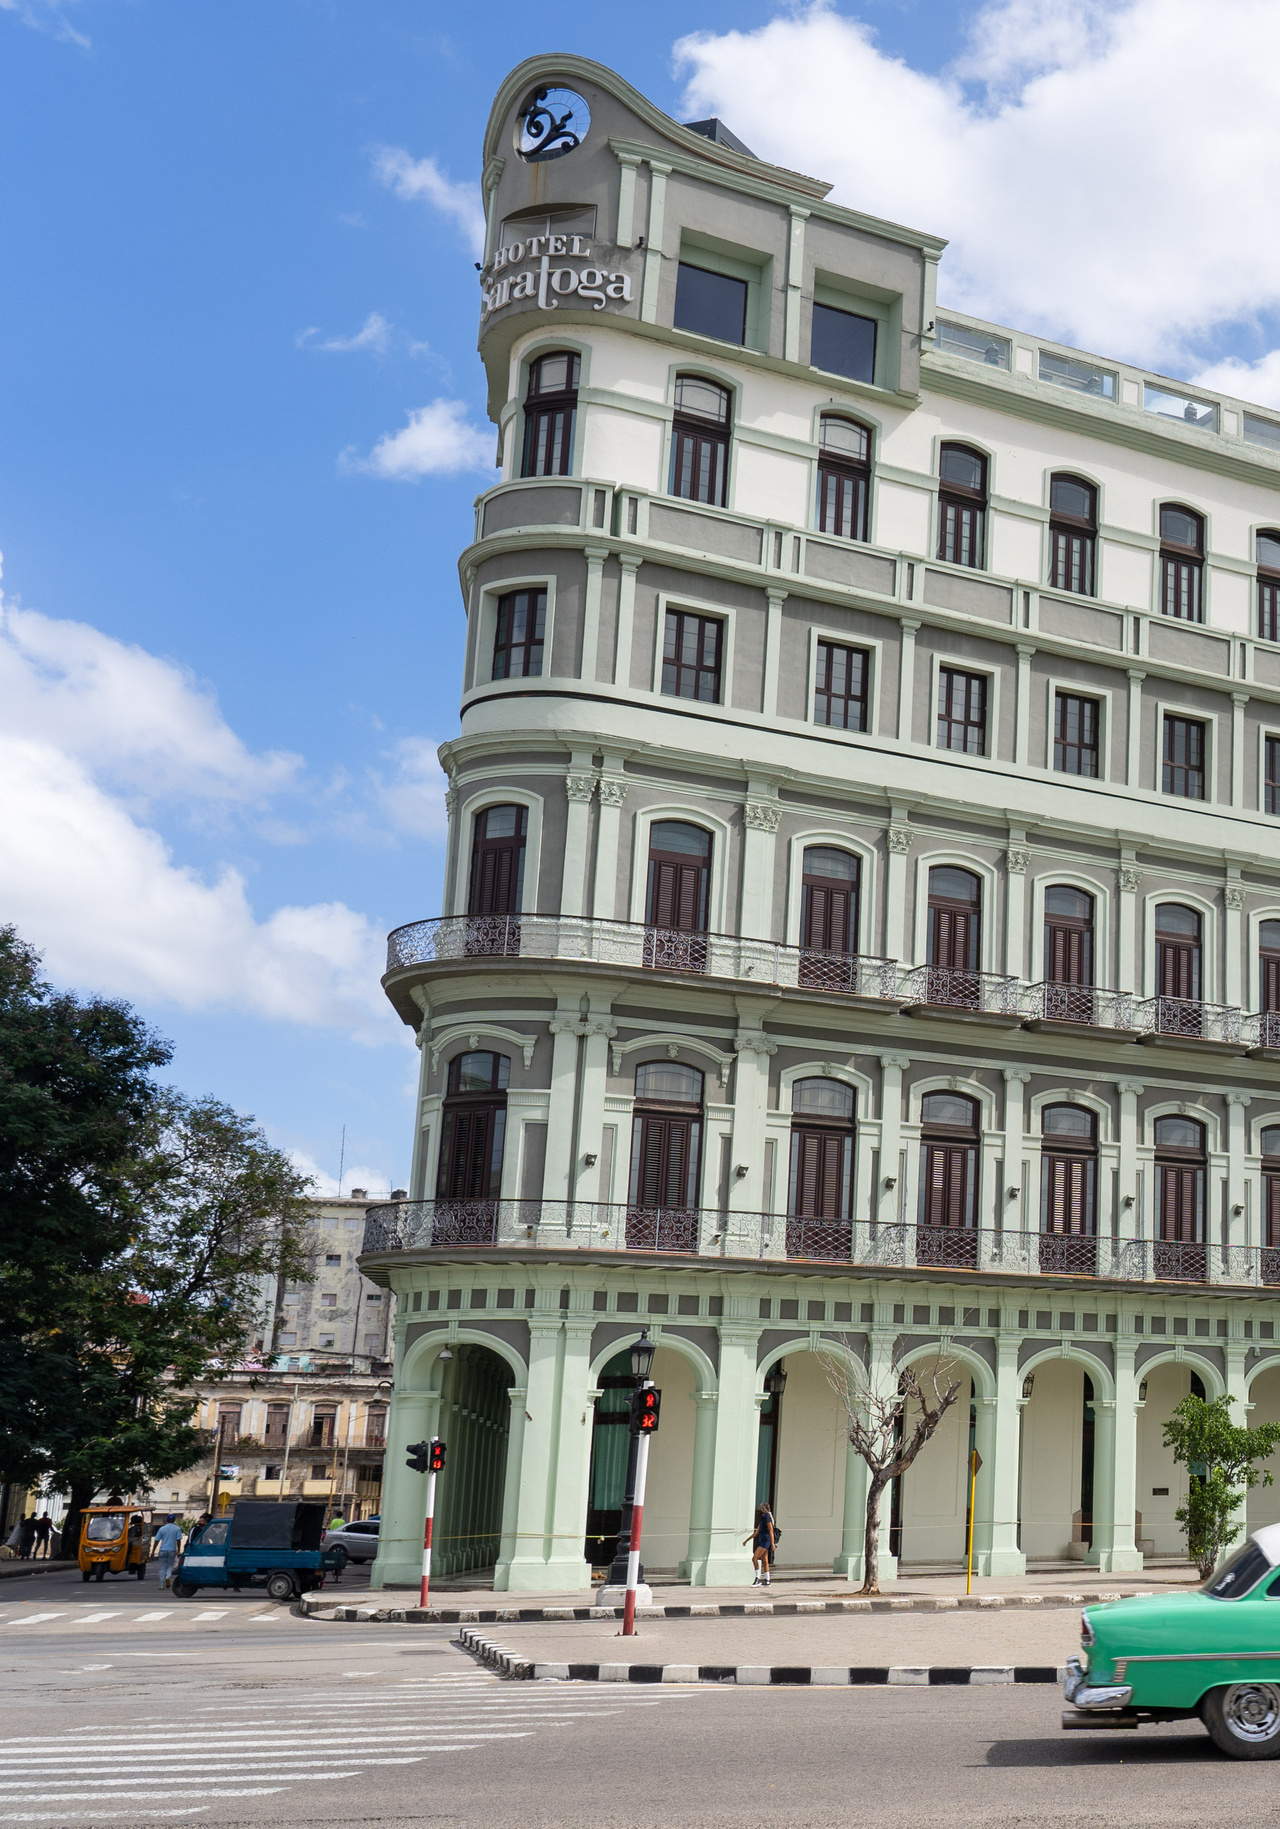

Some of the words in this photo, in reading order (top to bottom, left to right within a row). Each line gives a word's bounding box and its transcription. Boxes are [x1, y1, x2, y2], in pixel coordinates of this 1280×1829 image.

[493, 234, 591, 273] HOTEL
[481, 255, 635, 323] Saratoga
[642, 1414, 655, 1427] 32
